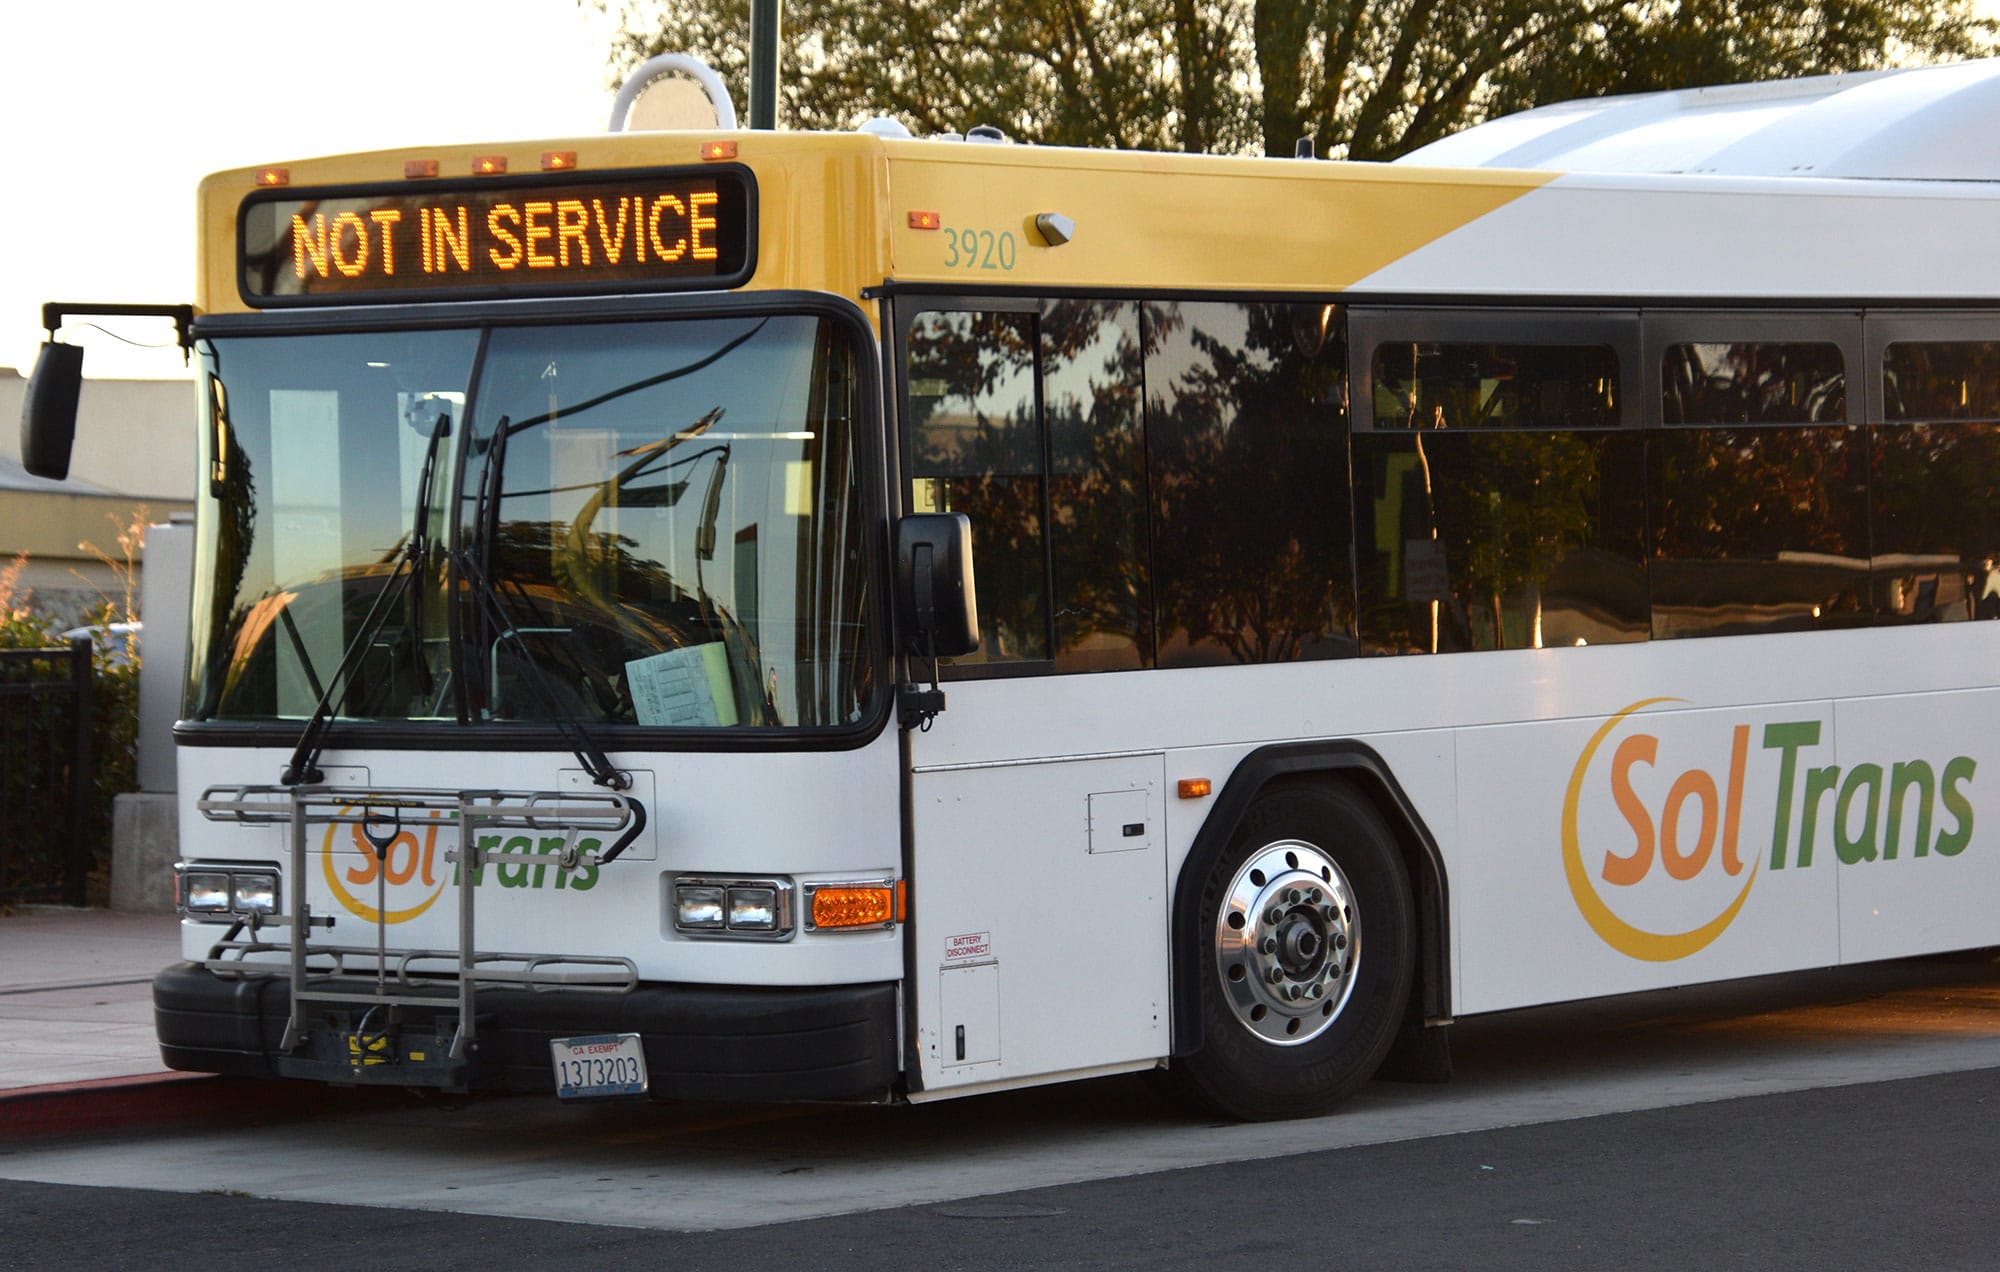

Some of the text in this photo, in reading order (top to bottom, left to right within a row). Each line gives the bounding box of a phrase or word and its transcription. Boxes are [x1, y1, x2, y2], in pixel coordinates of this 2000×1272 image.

[292, 191, 718, 279] NOT IN SERVICE
[943, 227, 1016, 271] 3920
[346, 810, 603, 891] Solrans
[947, 943, 988, 957] DISCONNECT
[953, 935, 982, 946] BATTERY
[572, 1043, 619, 1056] CA EXEMPT
[560, 1056, 639, 1088] 1373203
